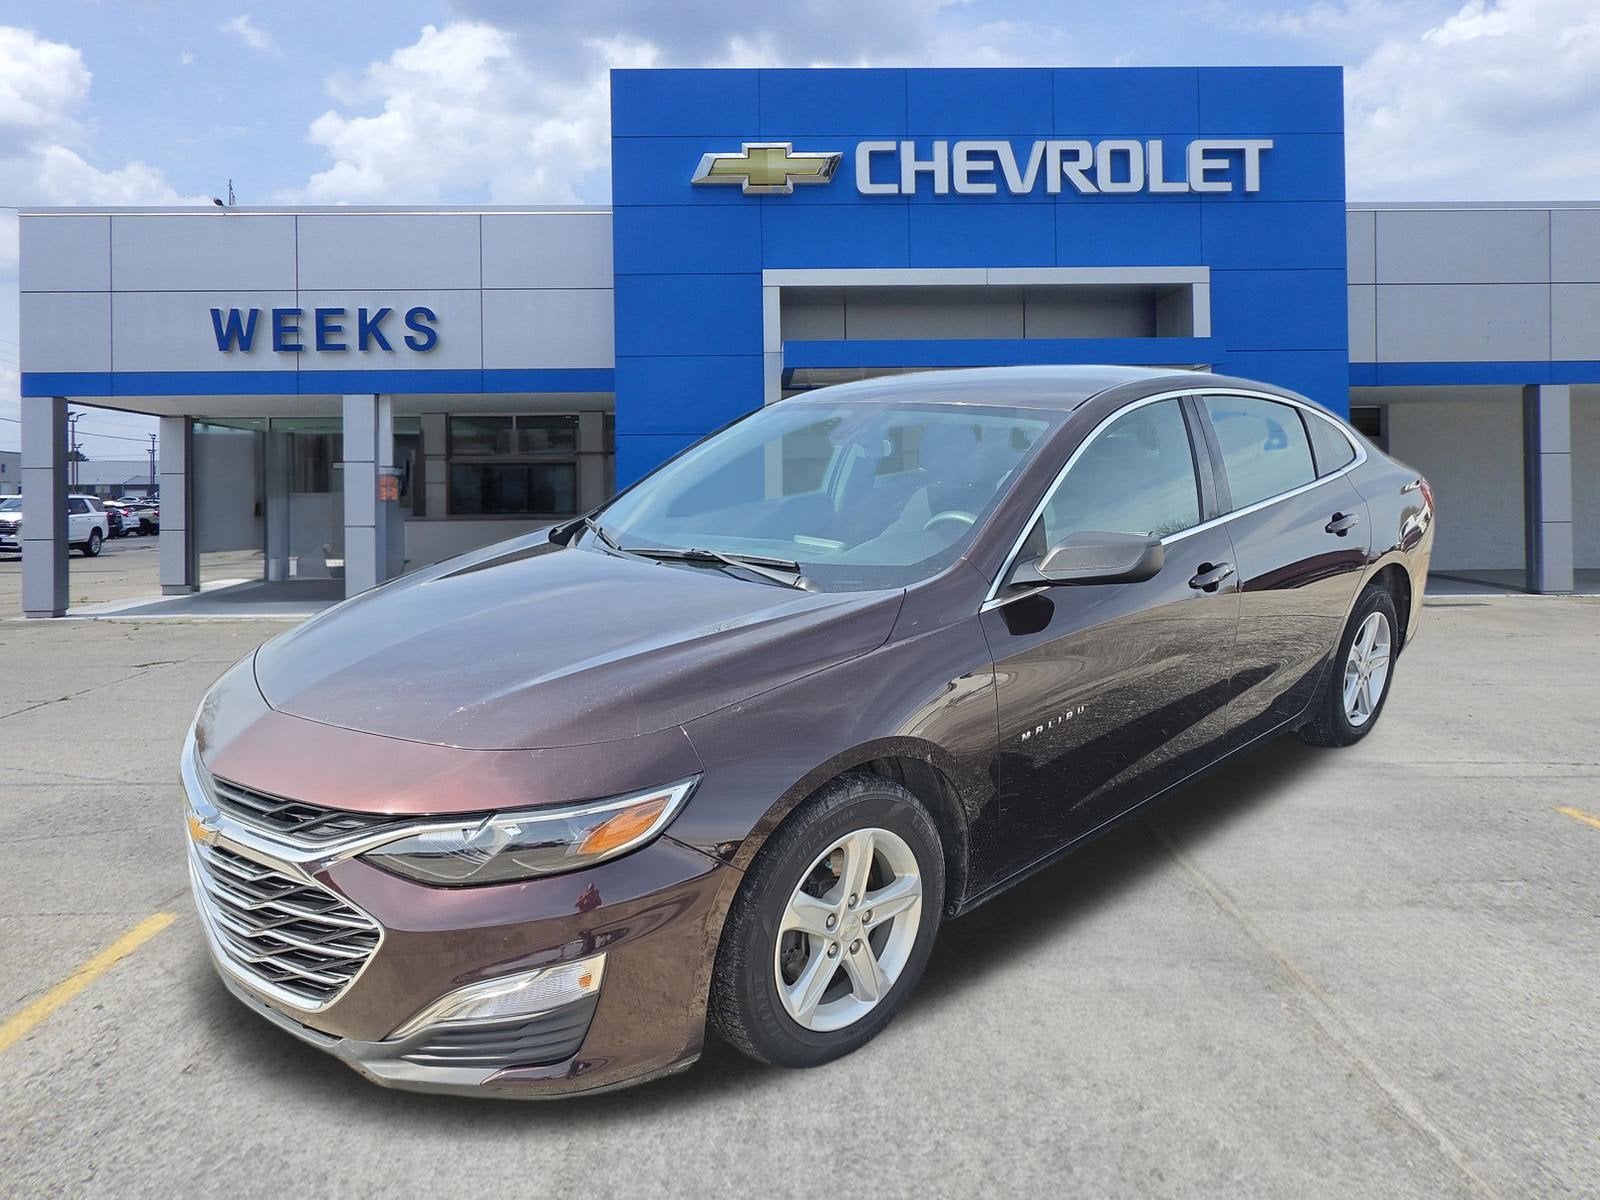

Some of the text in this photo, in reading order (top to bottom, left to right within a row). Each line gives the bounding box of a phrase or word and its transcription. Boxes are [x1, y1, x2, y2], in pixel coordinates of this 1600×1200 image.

[855, 138, 1274, 195] CHEVROLET
[210, 306, 438, 353] WEEKS
[1021, 704, 1085, 742] MALIBU
